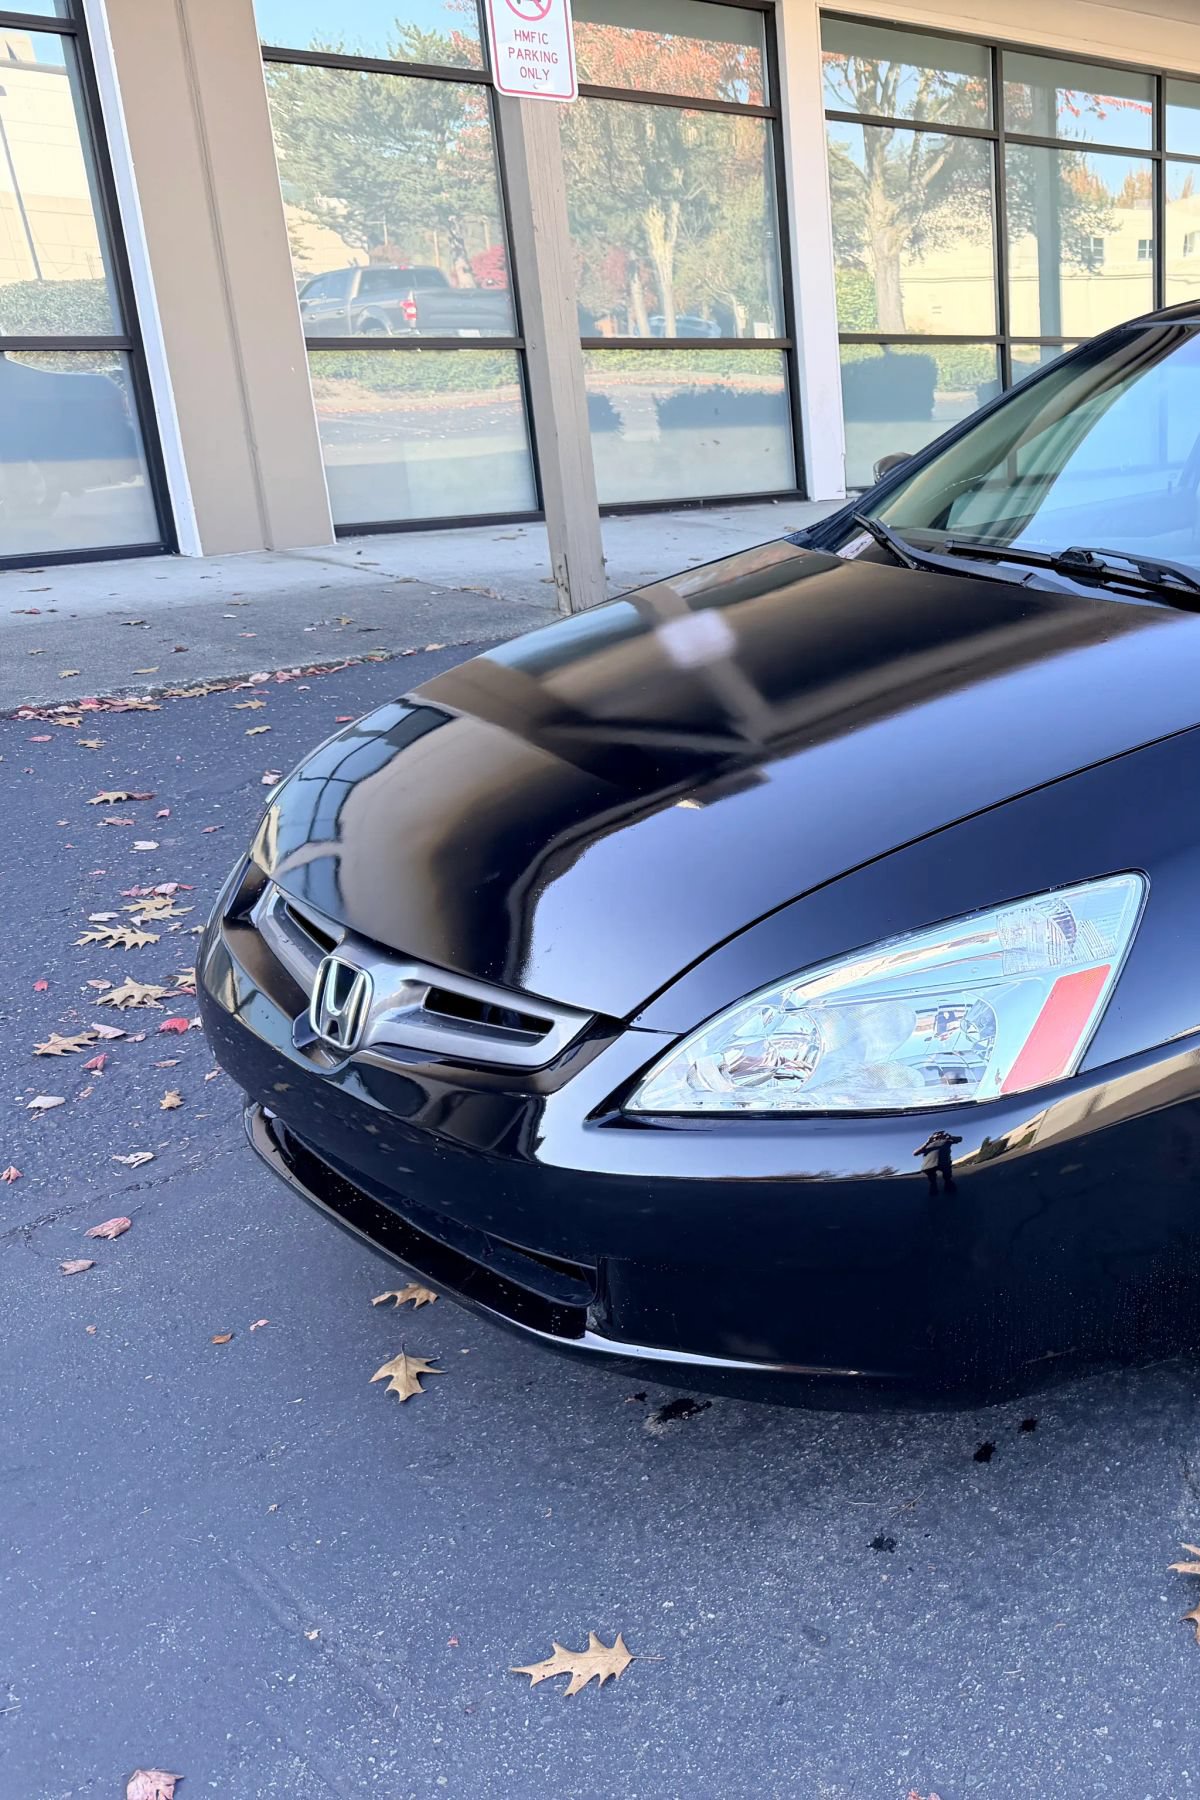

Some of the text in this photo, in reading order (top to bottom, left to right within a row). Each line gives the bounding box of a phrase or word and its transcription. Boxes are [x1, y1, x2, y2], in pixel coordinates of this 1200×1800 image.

[514, 29, 549, 45] HMFIC
[508, 46, 558, 64] PARKING
[520, 66, 550, 80] ONLY
